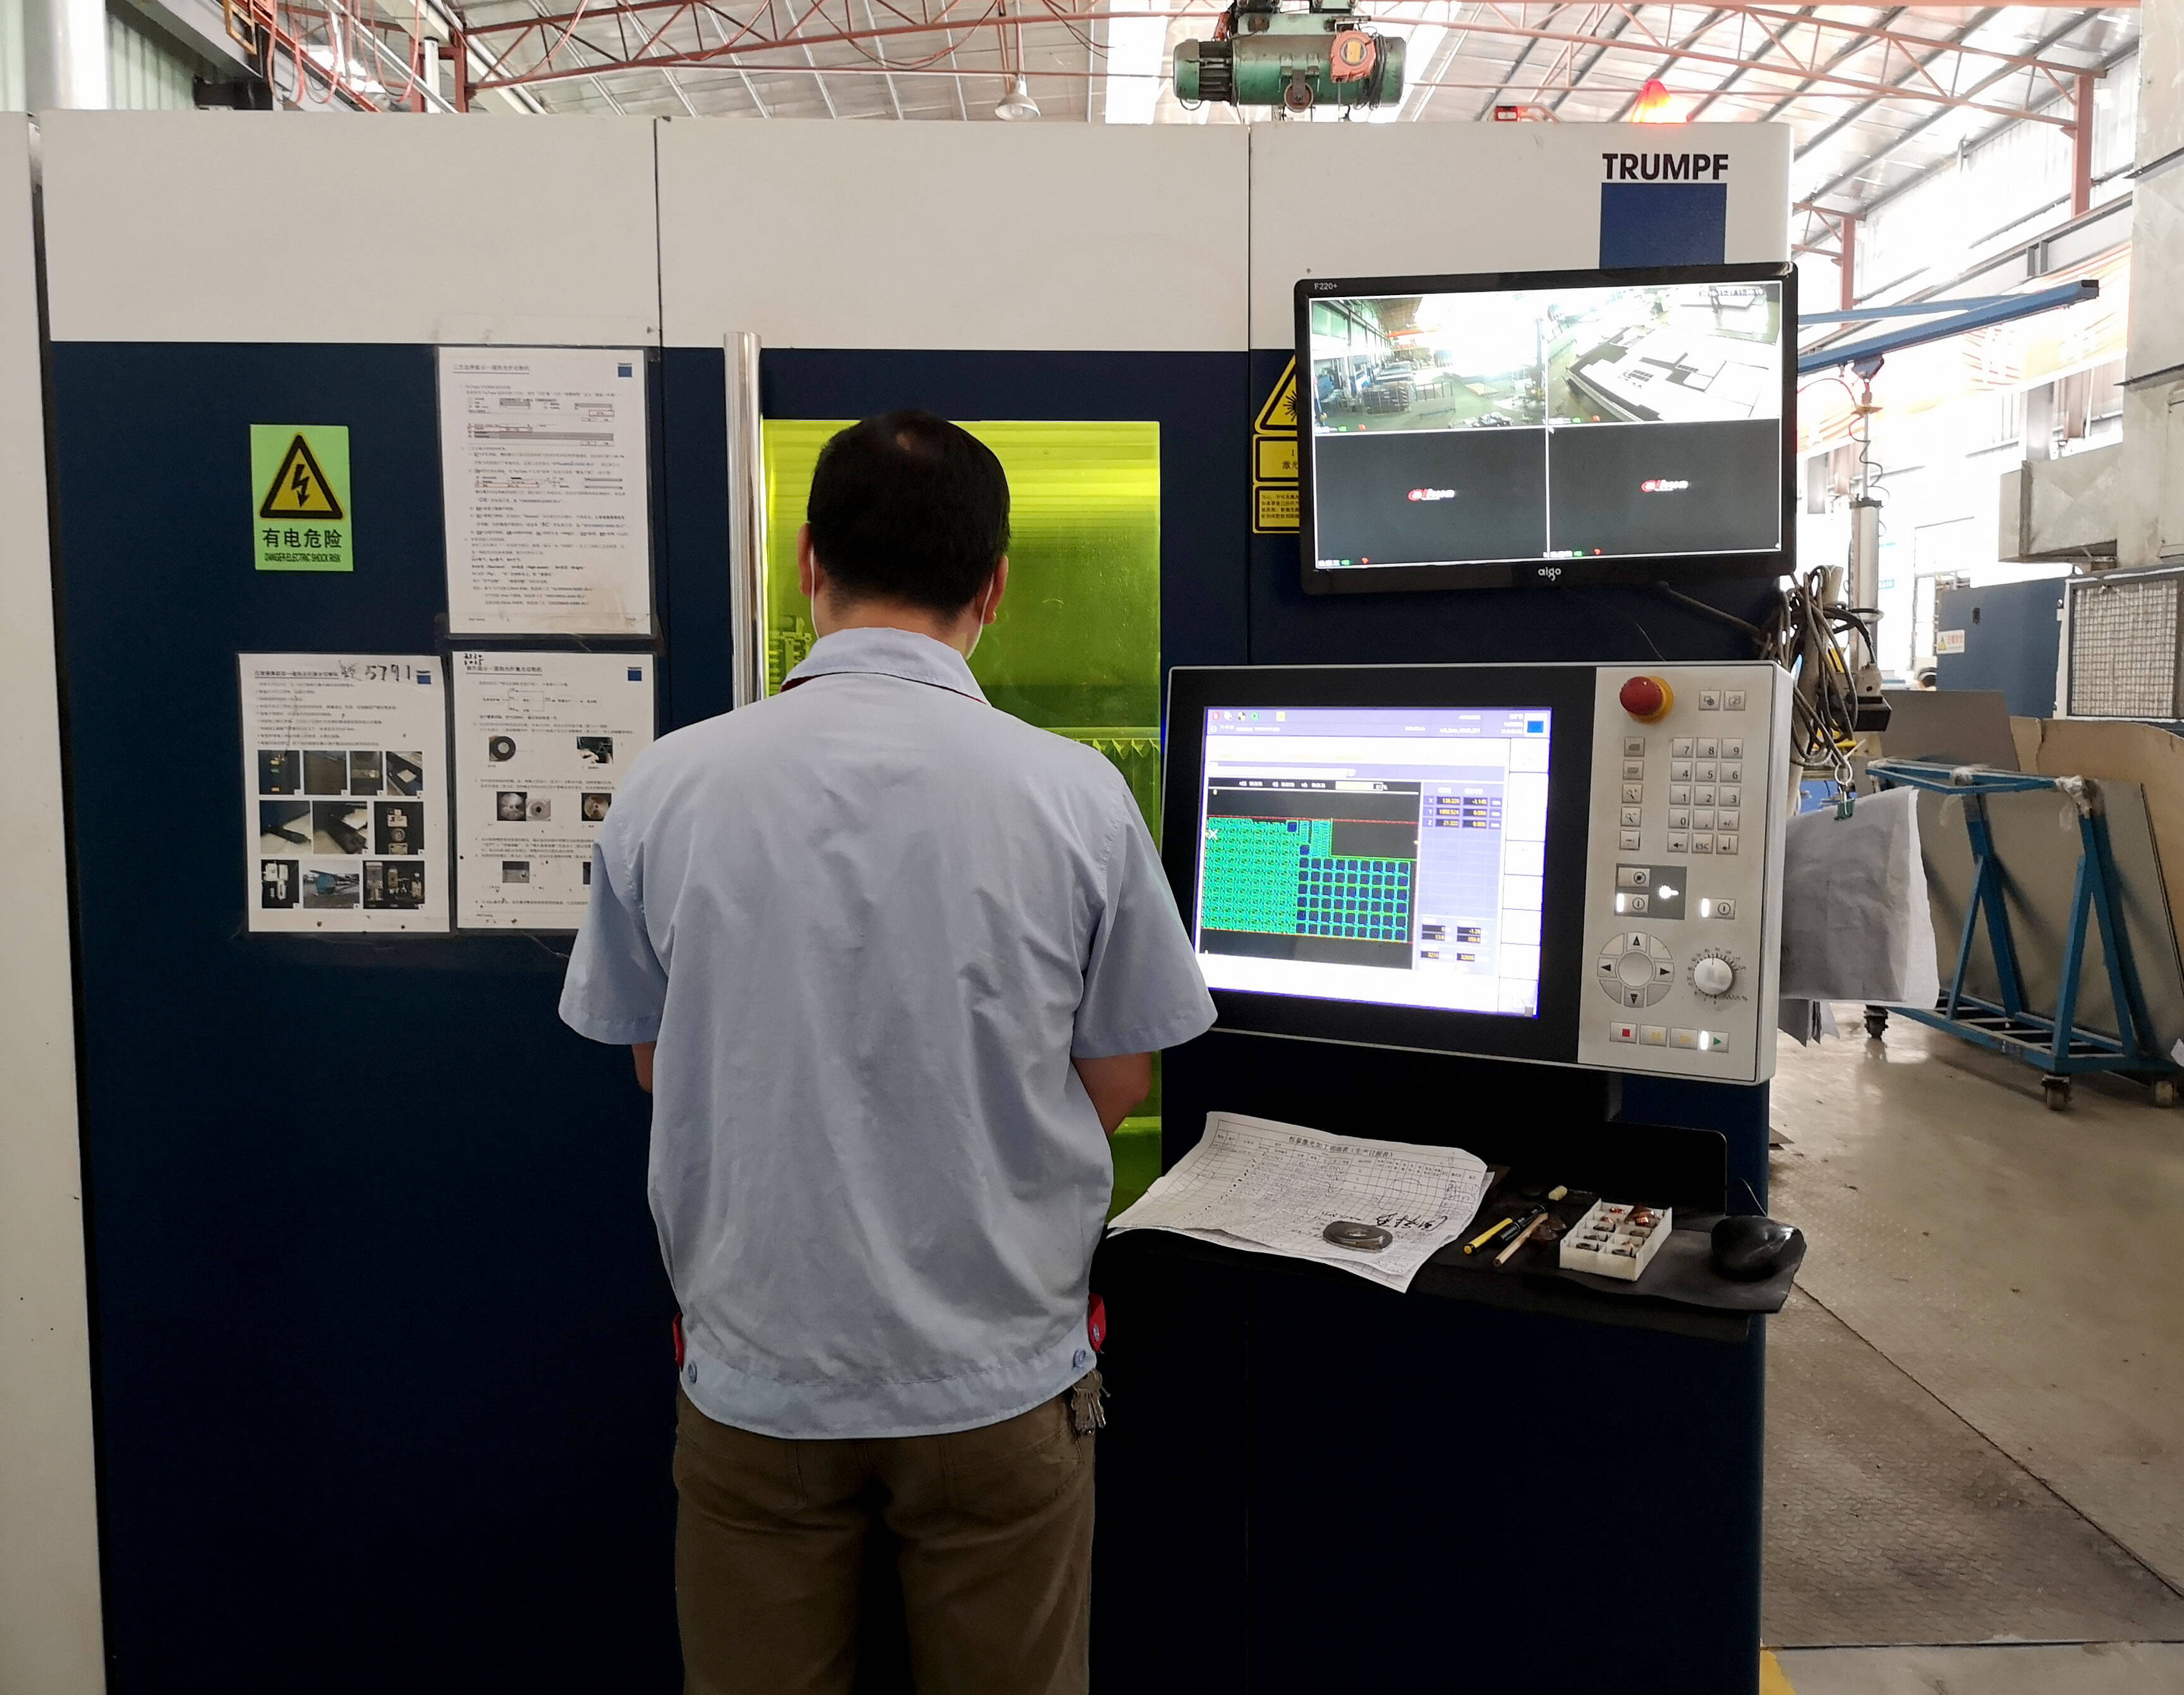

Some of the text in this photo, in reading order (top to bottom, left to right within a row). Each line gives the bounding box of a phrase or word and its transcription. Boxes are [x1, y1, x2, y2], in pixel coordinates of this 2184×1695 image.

[1602, 153, 1728, 180] TRUMPF
[1314, 282, 1338, 291] F220+
[262, 528, 342, 549] 有电危险
[1684, 746, 1739, 755] 7 8 9
[1682, 770, 1738, 779] 4 5 6
[1706, 794, 1712, 803] 2
[1731, 794, 1737, 803] 3
[1680, 817, 1686, 825] 0
